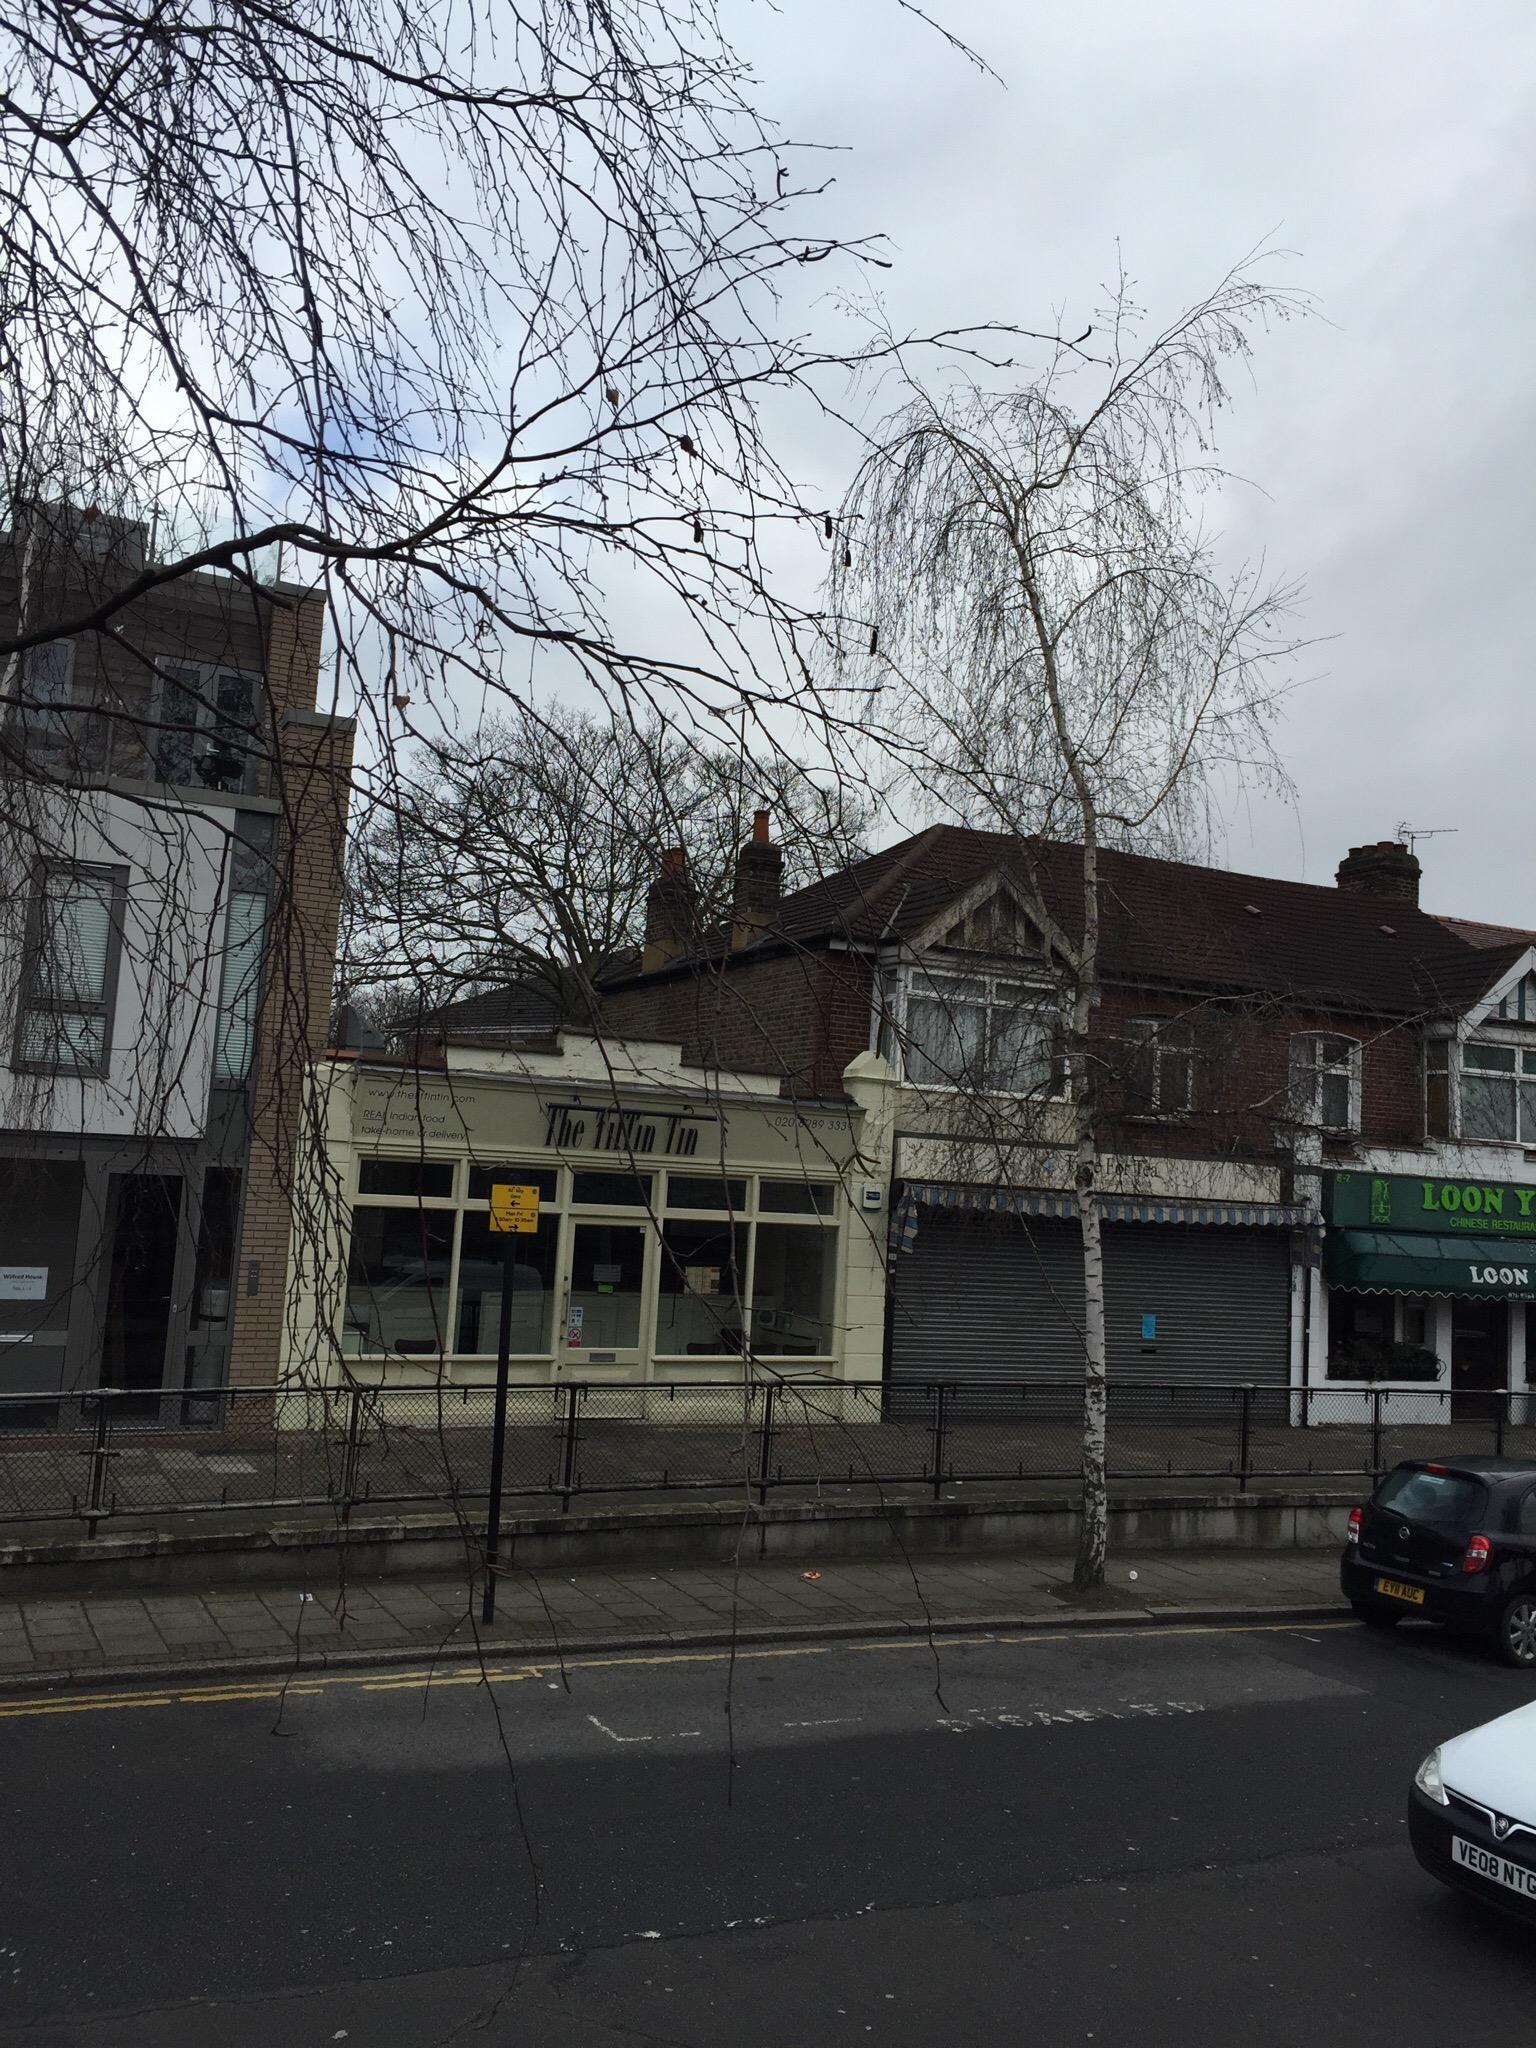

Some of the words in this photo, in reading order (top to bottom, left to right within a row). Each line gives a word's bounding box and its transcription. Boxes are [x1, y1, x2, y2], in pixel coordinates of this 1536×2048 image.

[368, 1088, 476, 1104] www.thetffintin.com
[389, 1111, 419, 1122] Indian
[422, 1114, 446, 1124] food
[361, 1125, 415, 1137] take-home
[427, 1128, 467, 1142] delivery
[544, 1107, 585, 1149] The
[664, 1116, 699, 1155] Tin
[1065, 1154, 1102, 1174] Te
[1136, 1160, 1158, 1178] Tea
[1421, 1182, 1504, 1215] LOON
[1450, 1216, 1489, 1230] CHINESE
[1491, 1219, 1536, 1232] RESTAURA
[1469, 1265, 1529, 1286] LOON
[1458, 1840, 1499, 1878] VE08
